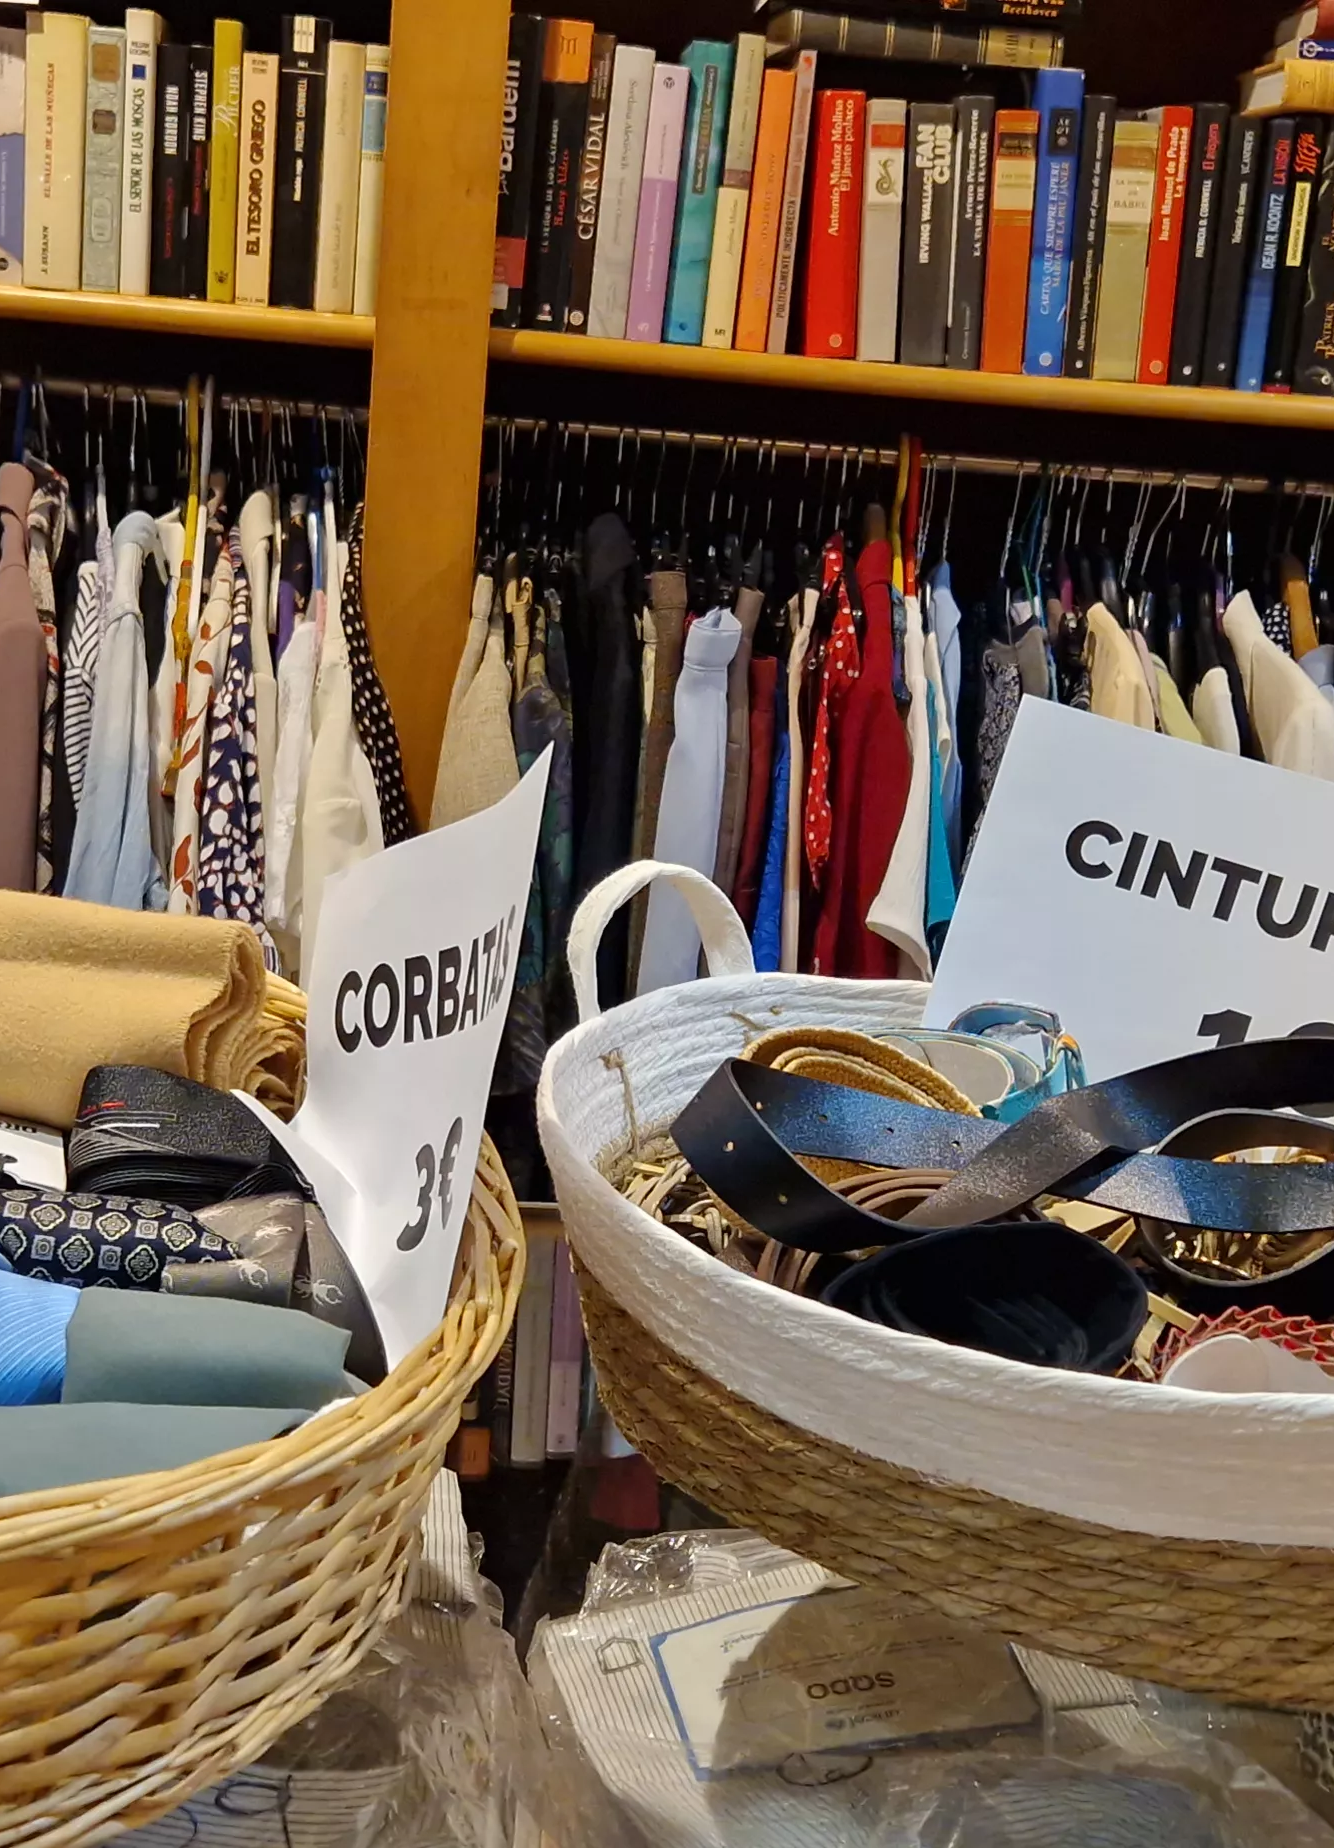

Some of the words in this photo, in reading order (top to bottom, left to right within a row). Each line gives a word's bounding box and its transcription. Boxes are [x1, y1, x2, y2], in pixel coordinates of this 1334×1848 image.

[1002, 4, 1058, 18] Beethoven
[44, 62, 55, 111] MUÑECAS
[165, 85, 179, 113] NOAH
[193, 71, 207, 114] STEPHEN
[131, 87, 145, 127] MOSCAS
[830, 100, 843, 141] Molina
[842, 100, 854, 141] polaco
[45, 116, 53, 134] LAS
[131, 131, 144, 148] LAS
[164, 115, 179, 155] GORDON
[192, 116, 207, 141] KING
[248, 99, 266, 164] GRIEGO
[45, 137, 53, 150] DE
[131, 151, 143, 164] DE
[583, 112, 606, 174] VIDAL
[915, 123, 936, 168] FAN
[933, 124, 952, 184] CLUB
[966, 109, 979, 182] Pérez-Reverte
[976, 132, 987, 181] FLANDES
[1165, 127, 1179, 158] Prada
[1175, 127, 1189, 182] tempestad
[1275, 140, 1289, 171] VISIÓN
[44, 154, 52, 183] VALLE
[546, 166, 556, 185] LOS
[830, 143, 843, 184] Muñoz
[840, 144, 853, 177] jinete
[1164, 160, 1176, 171] de
[1202, 161, 1215, 171] El
[44, 185, 51, 198] EL
[130, 166, 144, 199] SEÑOR
[840, 179, 850, 191] El
[975, 184, 985, 201] DE
[1057, 162, 1070, 196] JANER
[1091, 177, 1100, 188] de
[1160, 173, 1175, 215] Manuel
[1173, 184, 1183, 198] La
[1273, 172, 1286, 185] LA
[130, 201, 141, 212] EL
[246, 168, 263, 234] TESORO
[545, 188, 554, 202] DE
[576, 178, 599, 240] CÉSAR
[964, 184, 974, 220] Arturo
[1056, 198, 1067, 217] PAU
[1198, 180, 1212, 217] CORNWELL
[780, 200, 796, 252] INCORRECTA
[828, 188, 841, 236] Antonio
[973, 203, 984, 238] TABLA
[1043, 203, 1057, 248] SIEMPRE
[1055, 220, 1065, 233] LA
[1264, 193, 1284, 232] KOONTZ
[919, 224, 931, 264] IRVING
[1053, 235, 1065, 251] DE
[1158, 217, 1170, 240] Juan
[1195, 226, 1207, 257] PATRICIA
[1263, 232, 1277, 241] R.
[1321, 236, 1329, 245] EL
[41, 226, 50, 265] SUSANN
[246, 236, 260, 255] EL
[973, 241, 982, 256] LA
[1042, 251, 1053, 272] QUE
[1261, 243, 1276, 269] DEAN
[1040, 272, 1052, 314] CARTAS
[1077, 321, 1088, 351] Alberto
[1314, 302, 1334, 352] PATRICK
[334, 904, 516, 1053] CORBATAS
[396, 1115, 463, 1252] 3€
